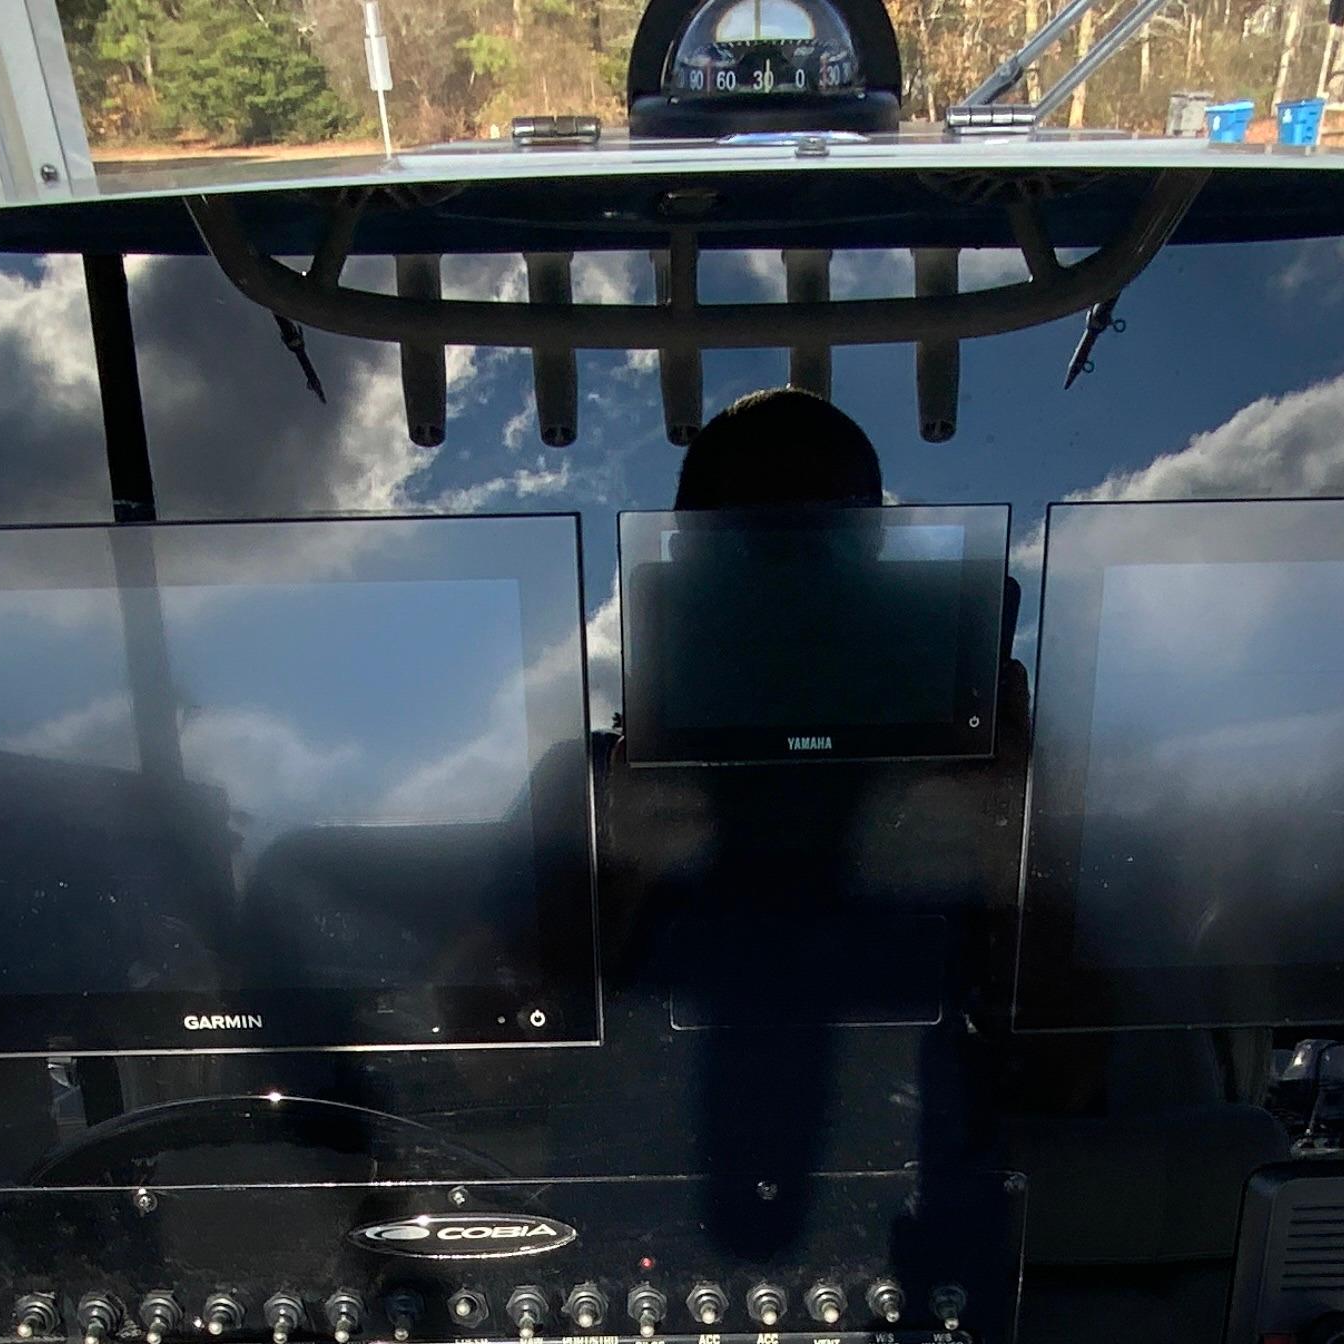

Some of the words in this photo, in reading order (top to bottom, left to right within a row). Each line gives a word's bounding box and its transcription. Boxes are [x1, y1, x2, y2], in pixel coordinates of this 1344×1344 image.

[717, 70, 736, 91] 60
[753, 70, 774, 91] 30
[796, 69, 805, 88] 0
[788, 737, 832, 750] YAMAHA
[184, 1014, 263, 1030] GARMIN
[437, 1223, 557, 1240] COBIA
[699, 1334, 720, 1344] ACC
[757, 1333, 778, 1344] ACC
